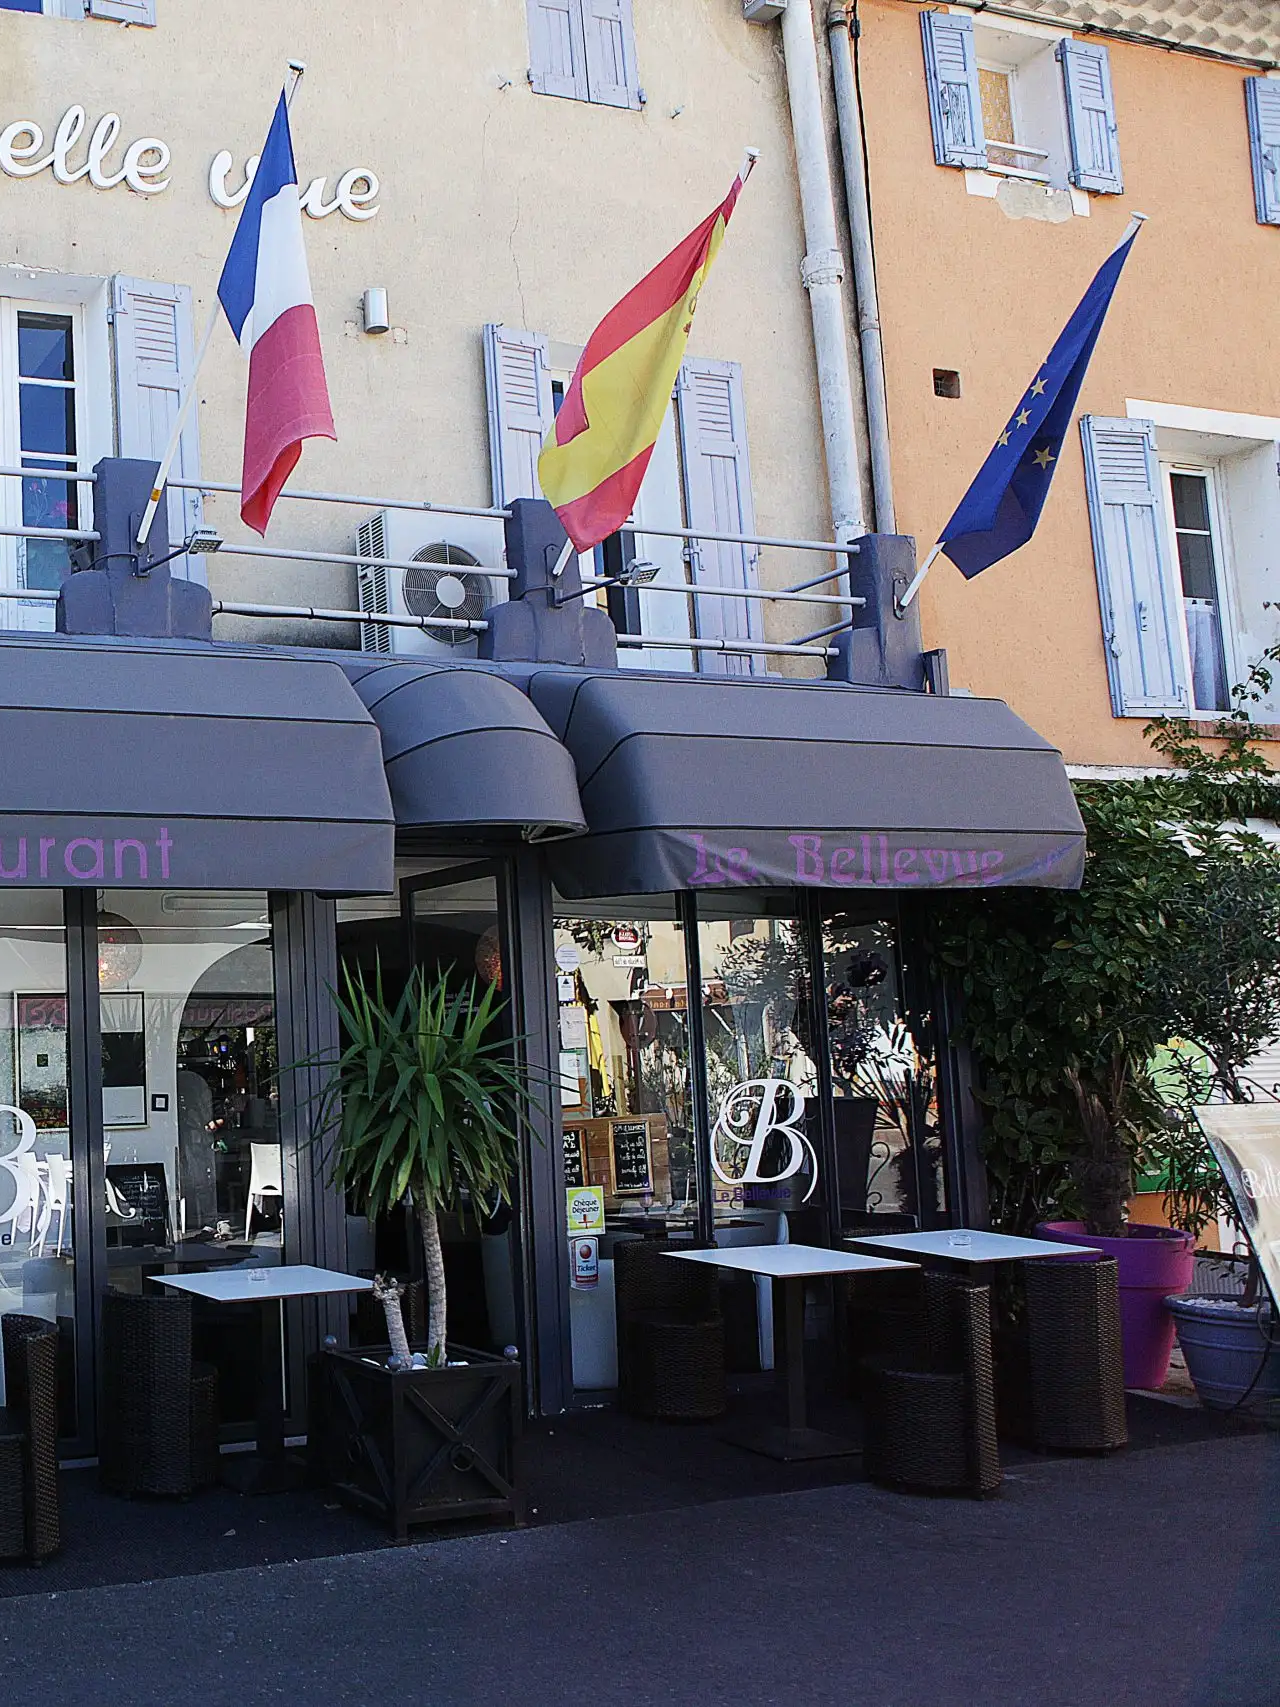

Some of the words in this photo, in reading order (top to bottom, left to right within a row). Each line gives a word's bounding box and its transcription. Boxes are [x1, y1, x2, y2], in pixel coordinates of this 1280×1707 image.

[686, 833, 758, 885] Le
[786, 833, 1008, 886] Bellevue
[712, 1188, 729, 1203] Le
[733, 1186, 791, 1202] Bellevue
[573, 1199, 597, 1207] Chèque
[572, 1206, 600, 1214] Déjeuner
[577, 1264, 596, 1272] Ticket
